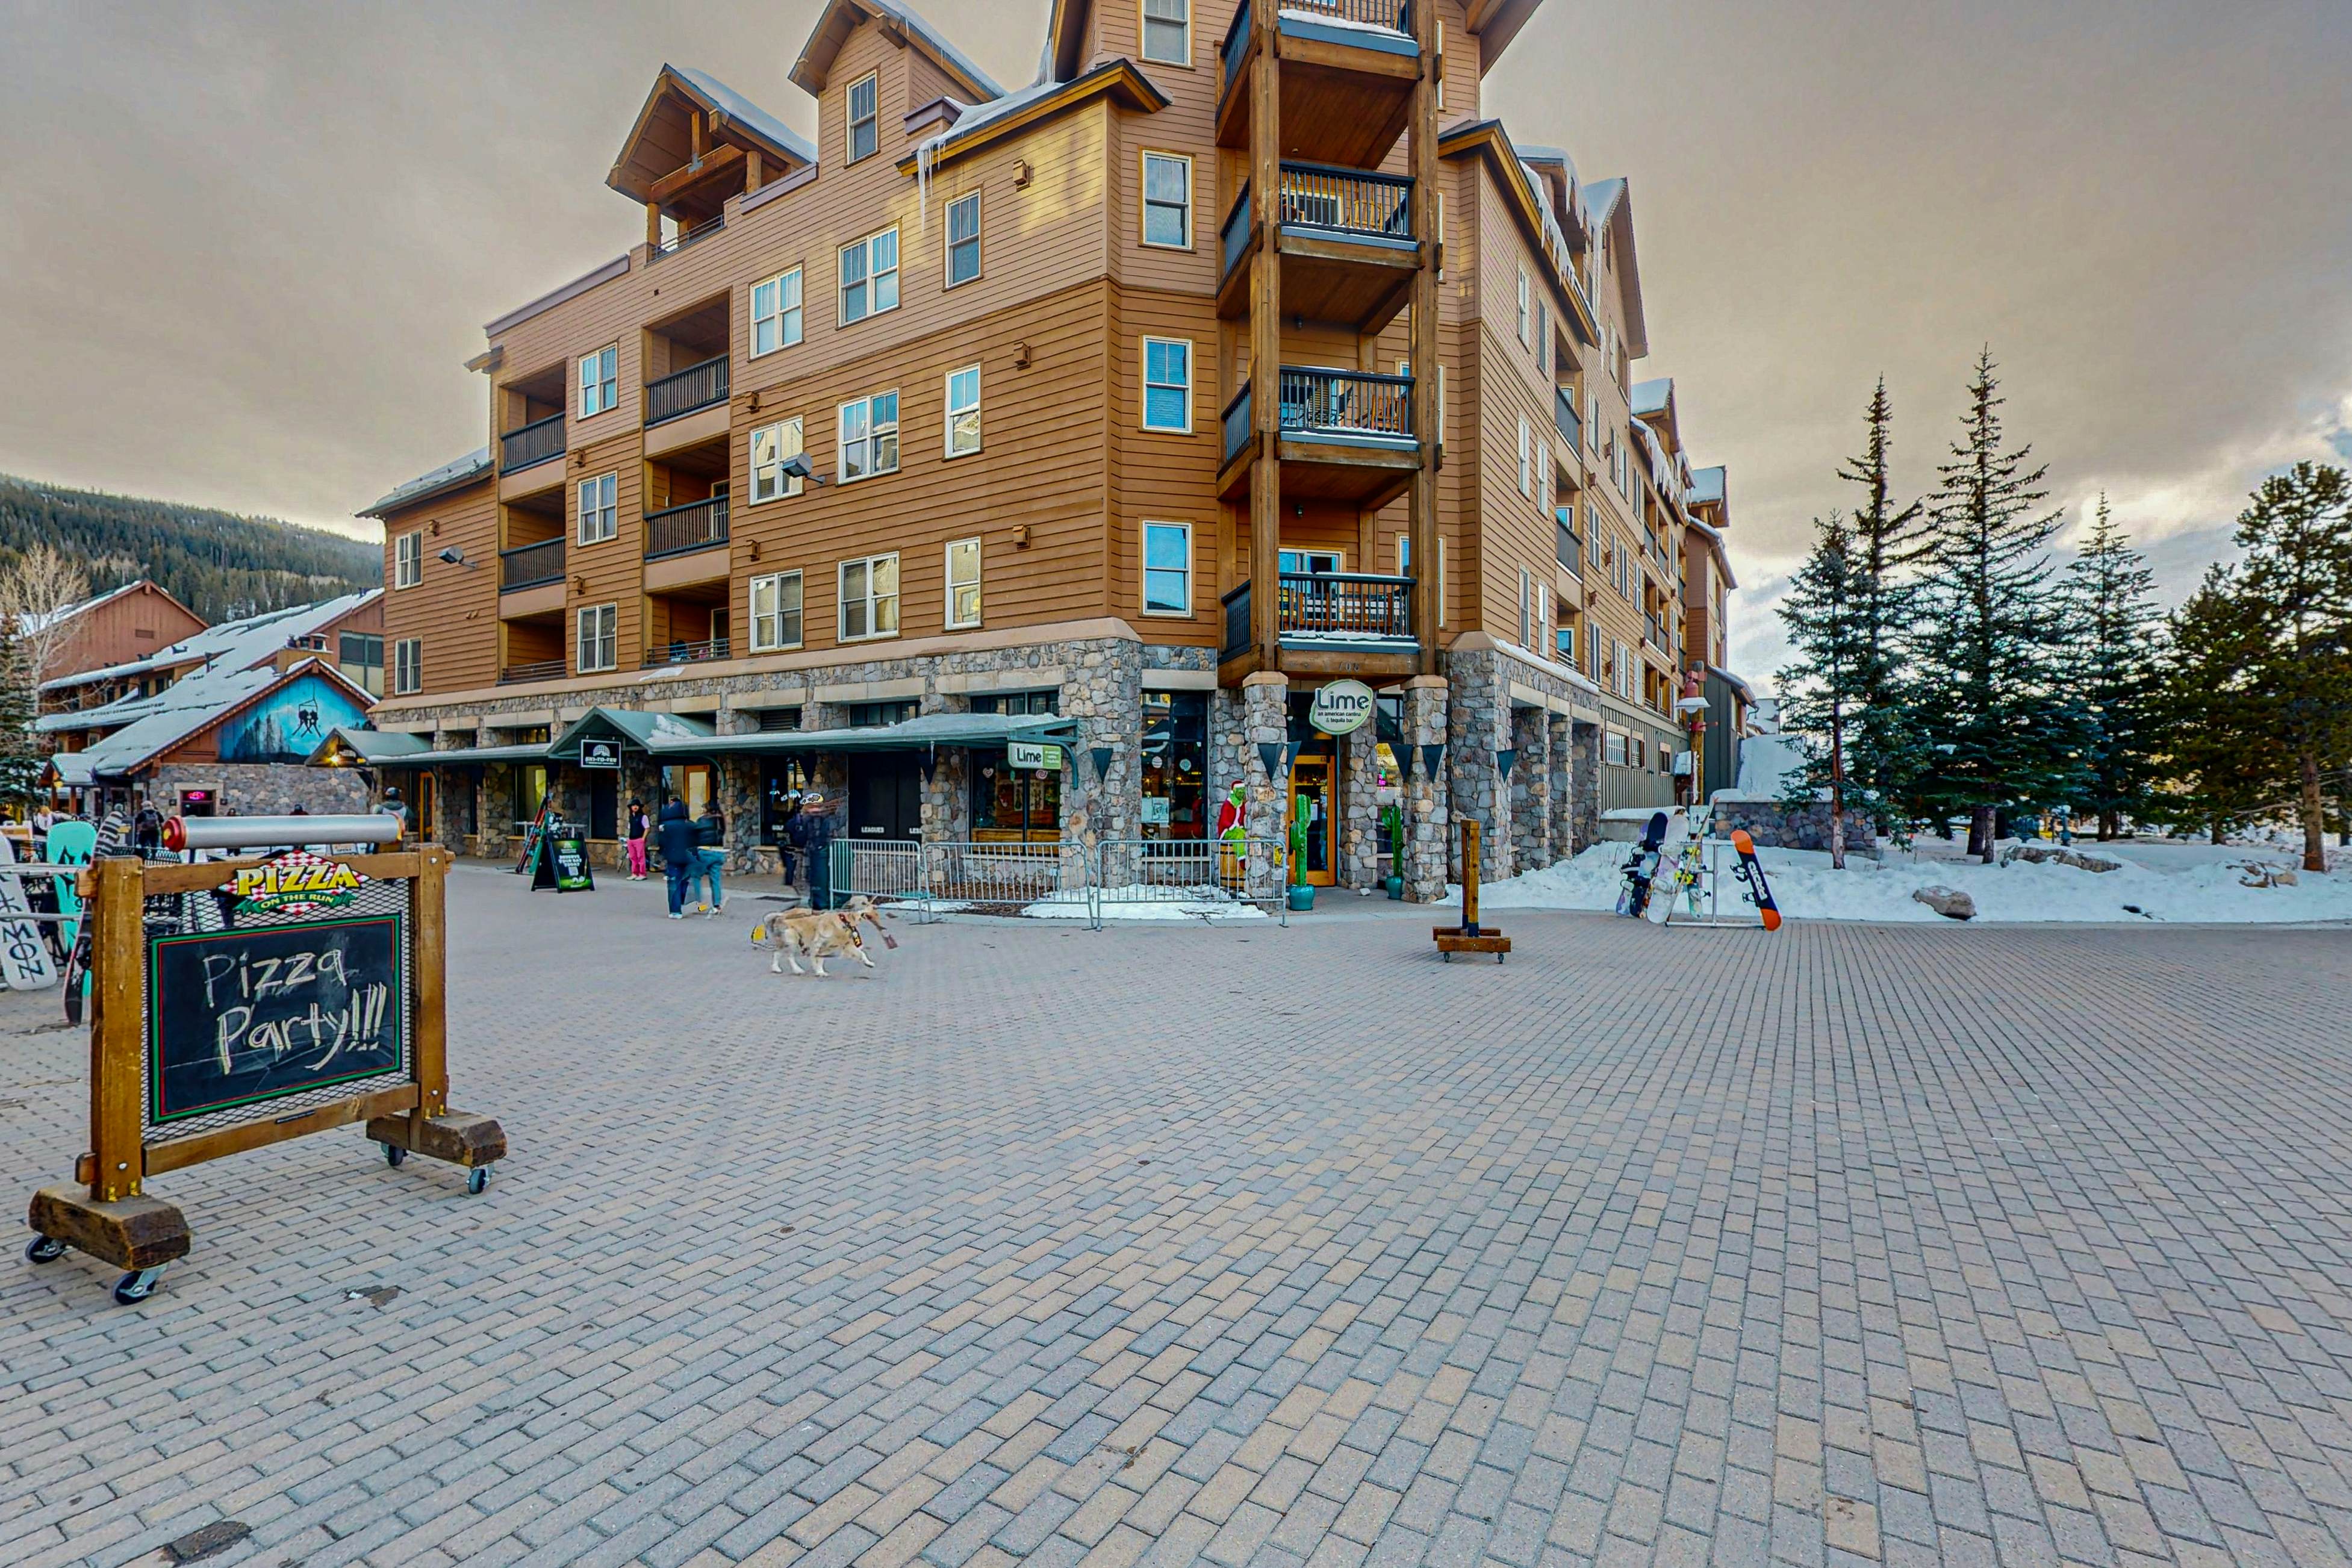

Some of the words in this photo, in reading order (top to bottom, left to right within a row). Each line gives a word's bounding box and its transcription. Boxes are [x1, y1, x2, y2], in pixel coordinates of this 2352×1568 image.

[1316, 688, 1369, 709] Lime
[1017, 747, 1042, 763] Lime
[237, 862, 360, 896] PIZZA
[261, 898, 280, 909] ON
[309, 894, 334, 903] RUN
[202, 948, 347, 1009] Pizza
[217, 981, 387, 1076] Party!!!
